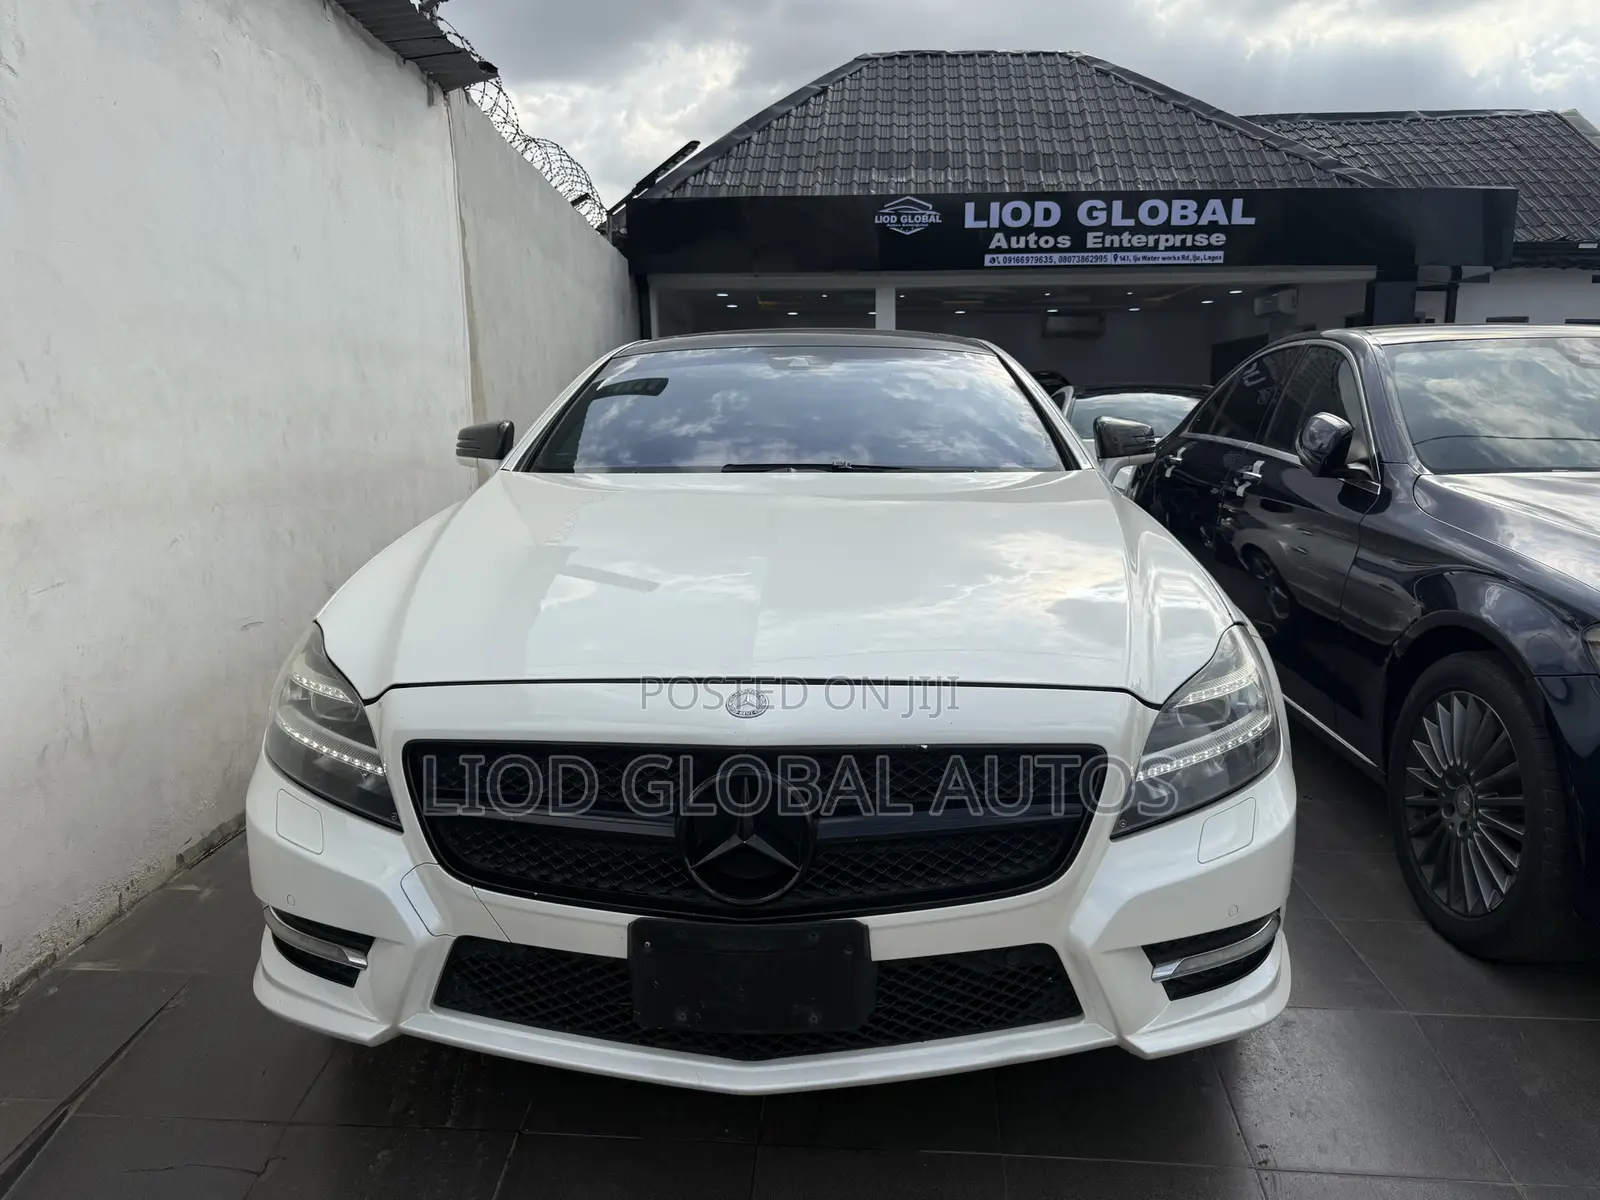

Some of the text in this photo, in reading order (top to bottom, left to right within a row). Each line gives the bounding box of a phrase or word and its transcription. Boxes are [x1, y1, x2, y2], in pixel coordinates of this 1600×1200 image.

[874, 215, 942, 224] LIOD GLOBAL
[964, 198, 1256, 228] LIOD GLOBAL
[988, 231, 1227, 250] Autos Enterprise
[1203, 254, 1222, 262] Lagos
